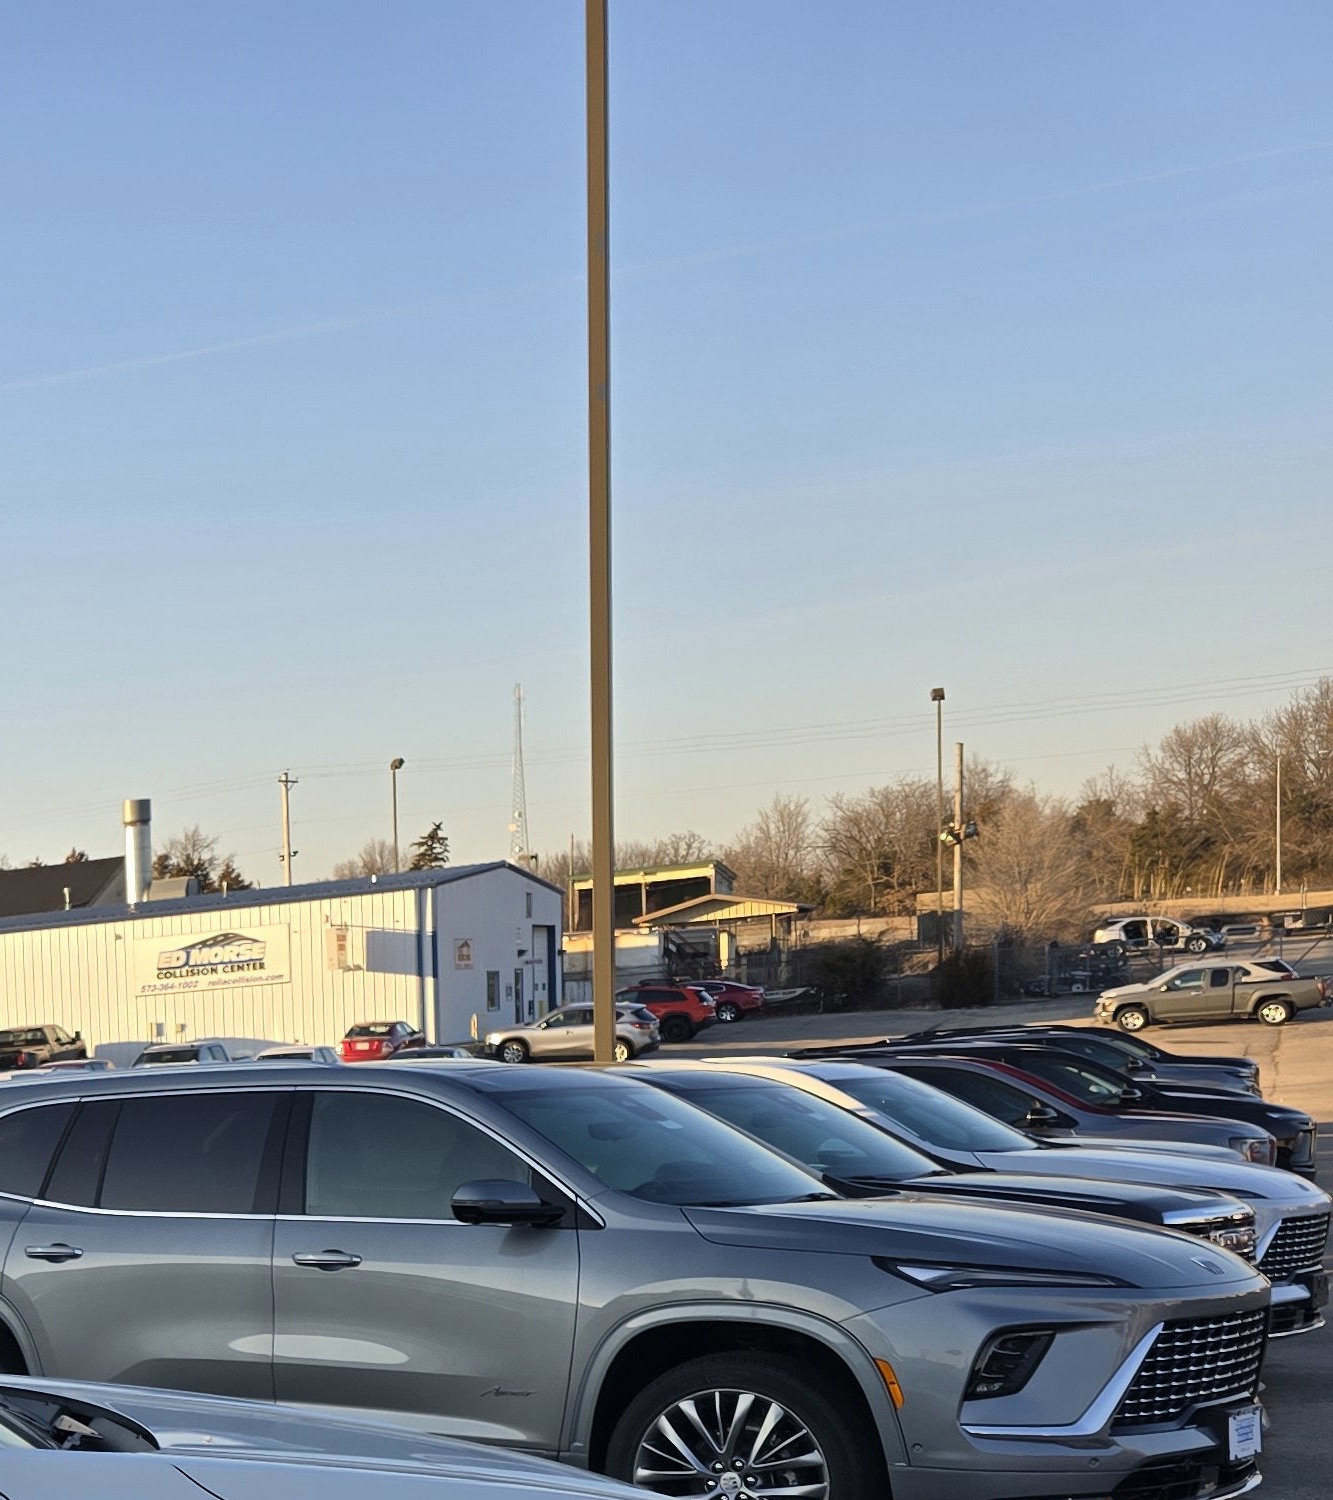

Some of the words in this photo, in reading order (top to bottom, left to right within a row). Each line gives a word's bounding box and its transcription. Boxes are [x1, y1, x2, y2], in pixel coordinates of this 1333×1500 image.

[157, 950, 187, 970] ED
[188, 941, 266, 966] MORSE
[156, 966, 219, 980] COLLISION
[222, 962, 266, 974] CENTER
